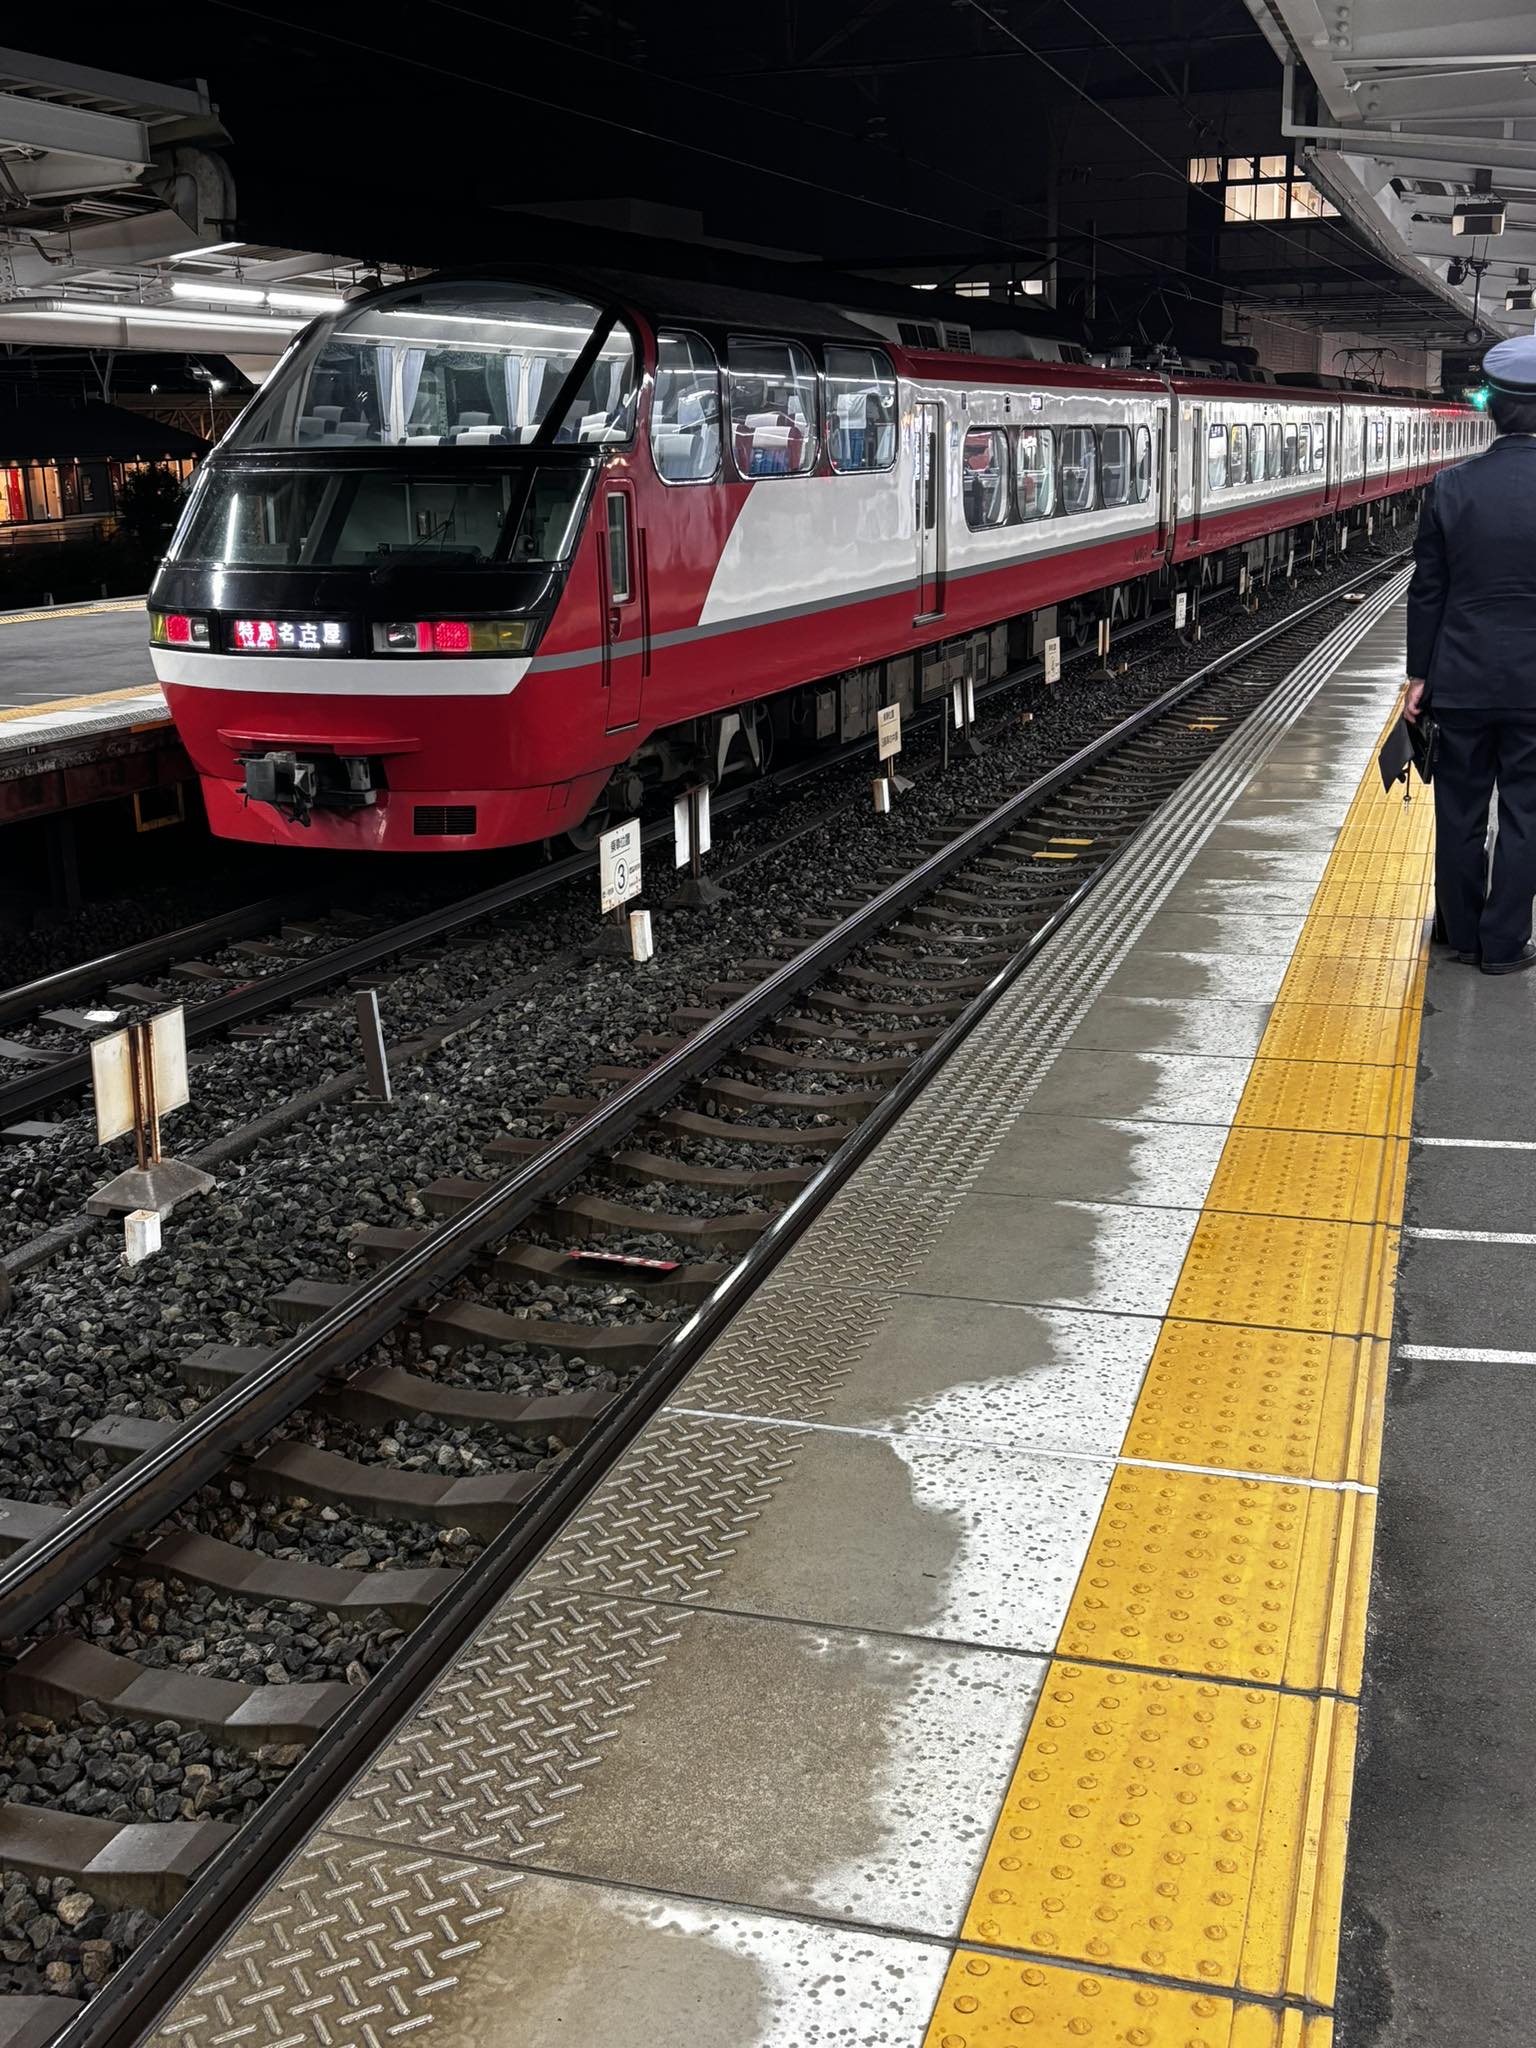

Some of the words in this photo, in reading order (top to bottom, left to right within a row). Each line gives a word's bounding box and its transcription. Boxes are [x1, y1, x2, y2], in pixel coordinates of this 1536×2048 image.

[238, 621, 274, 642] 特急
[278, 622, 341, 644] 名古屋
